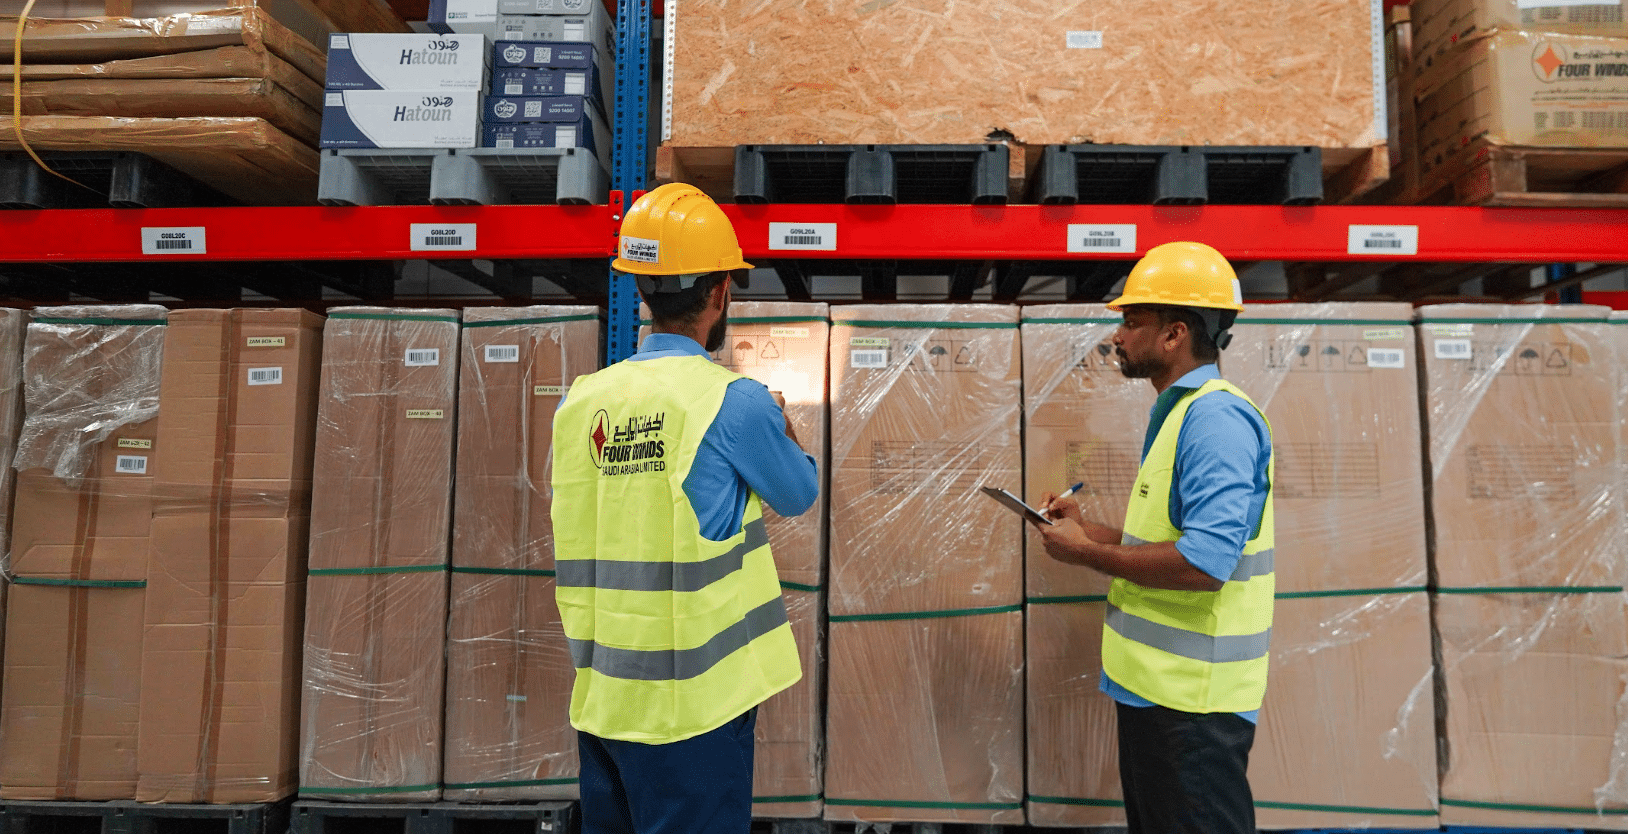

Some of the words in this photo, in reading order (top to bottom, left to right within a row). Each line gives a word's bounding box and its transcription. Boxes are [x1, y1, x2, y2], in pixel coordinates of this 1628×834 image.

[400, 47, 458, 65] Hatoun
[1558, 64, 1591, 77] FOUR
[393, 104, 452, 122] Hatoun
[603, 445, 632, 463] FOUR
[632, 440, 665, 461] WINDS
[602, 465, 619, 477] SAUDI
